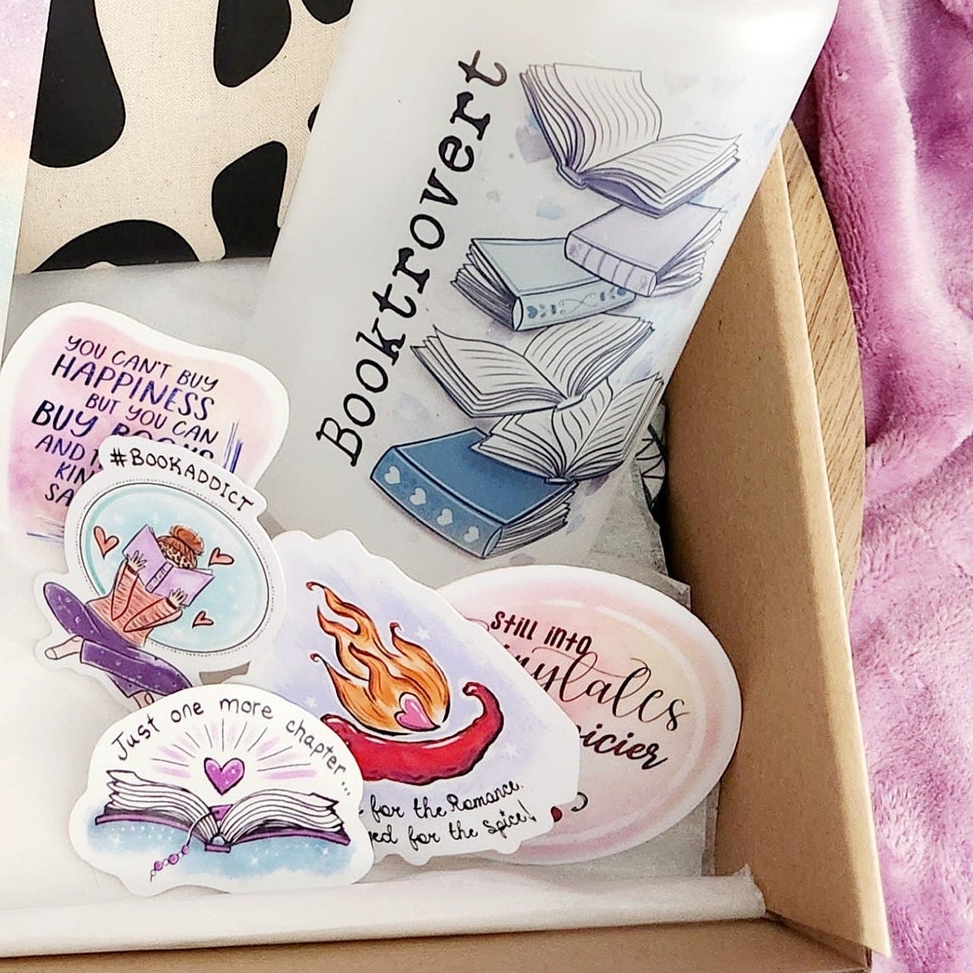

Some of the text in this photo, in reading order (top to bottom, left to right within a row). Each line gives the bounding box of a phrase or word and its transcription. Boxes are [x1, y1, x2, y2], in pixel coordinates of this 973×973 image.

[316, 49, 507, 466] Booktrovert
[65, 334, 219, 393] YOU CAN'T BUY
[51, 353, 215, 422] HAPPINESS
[31, 399, 99, 438] BUY
[85, 392, 121, 415] BUT
[125, 404, 168, 430] YOU
[171, 420, 220, 445] CAN
[34, 434, 86, 462] AND
[54, 461, 95, 486] KIN
[110, 447, 255, 513] #BOOKADDICT
[44, 483, 75, 507] SA
[543, 626, 593, 655] into
[111, 713, 163, 762] Just
[170, 700, 205, 724] one
[219, 698, 274, 720] more
[370, 794, 405, 824] for
[413, 796, 447, 819] the
[408, 825, 440, 851] for
[448, 820, 478, 841] the
